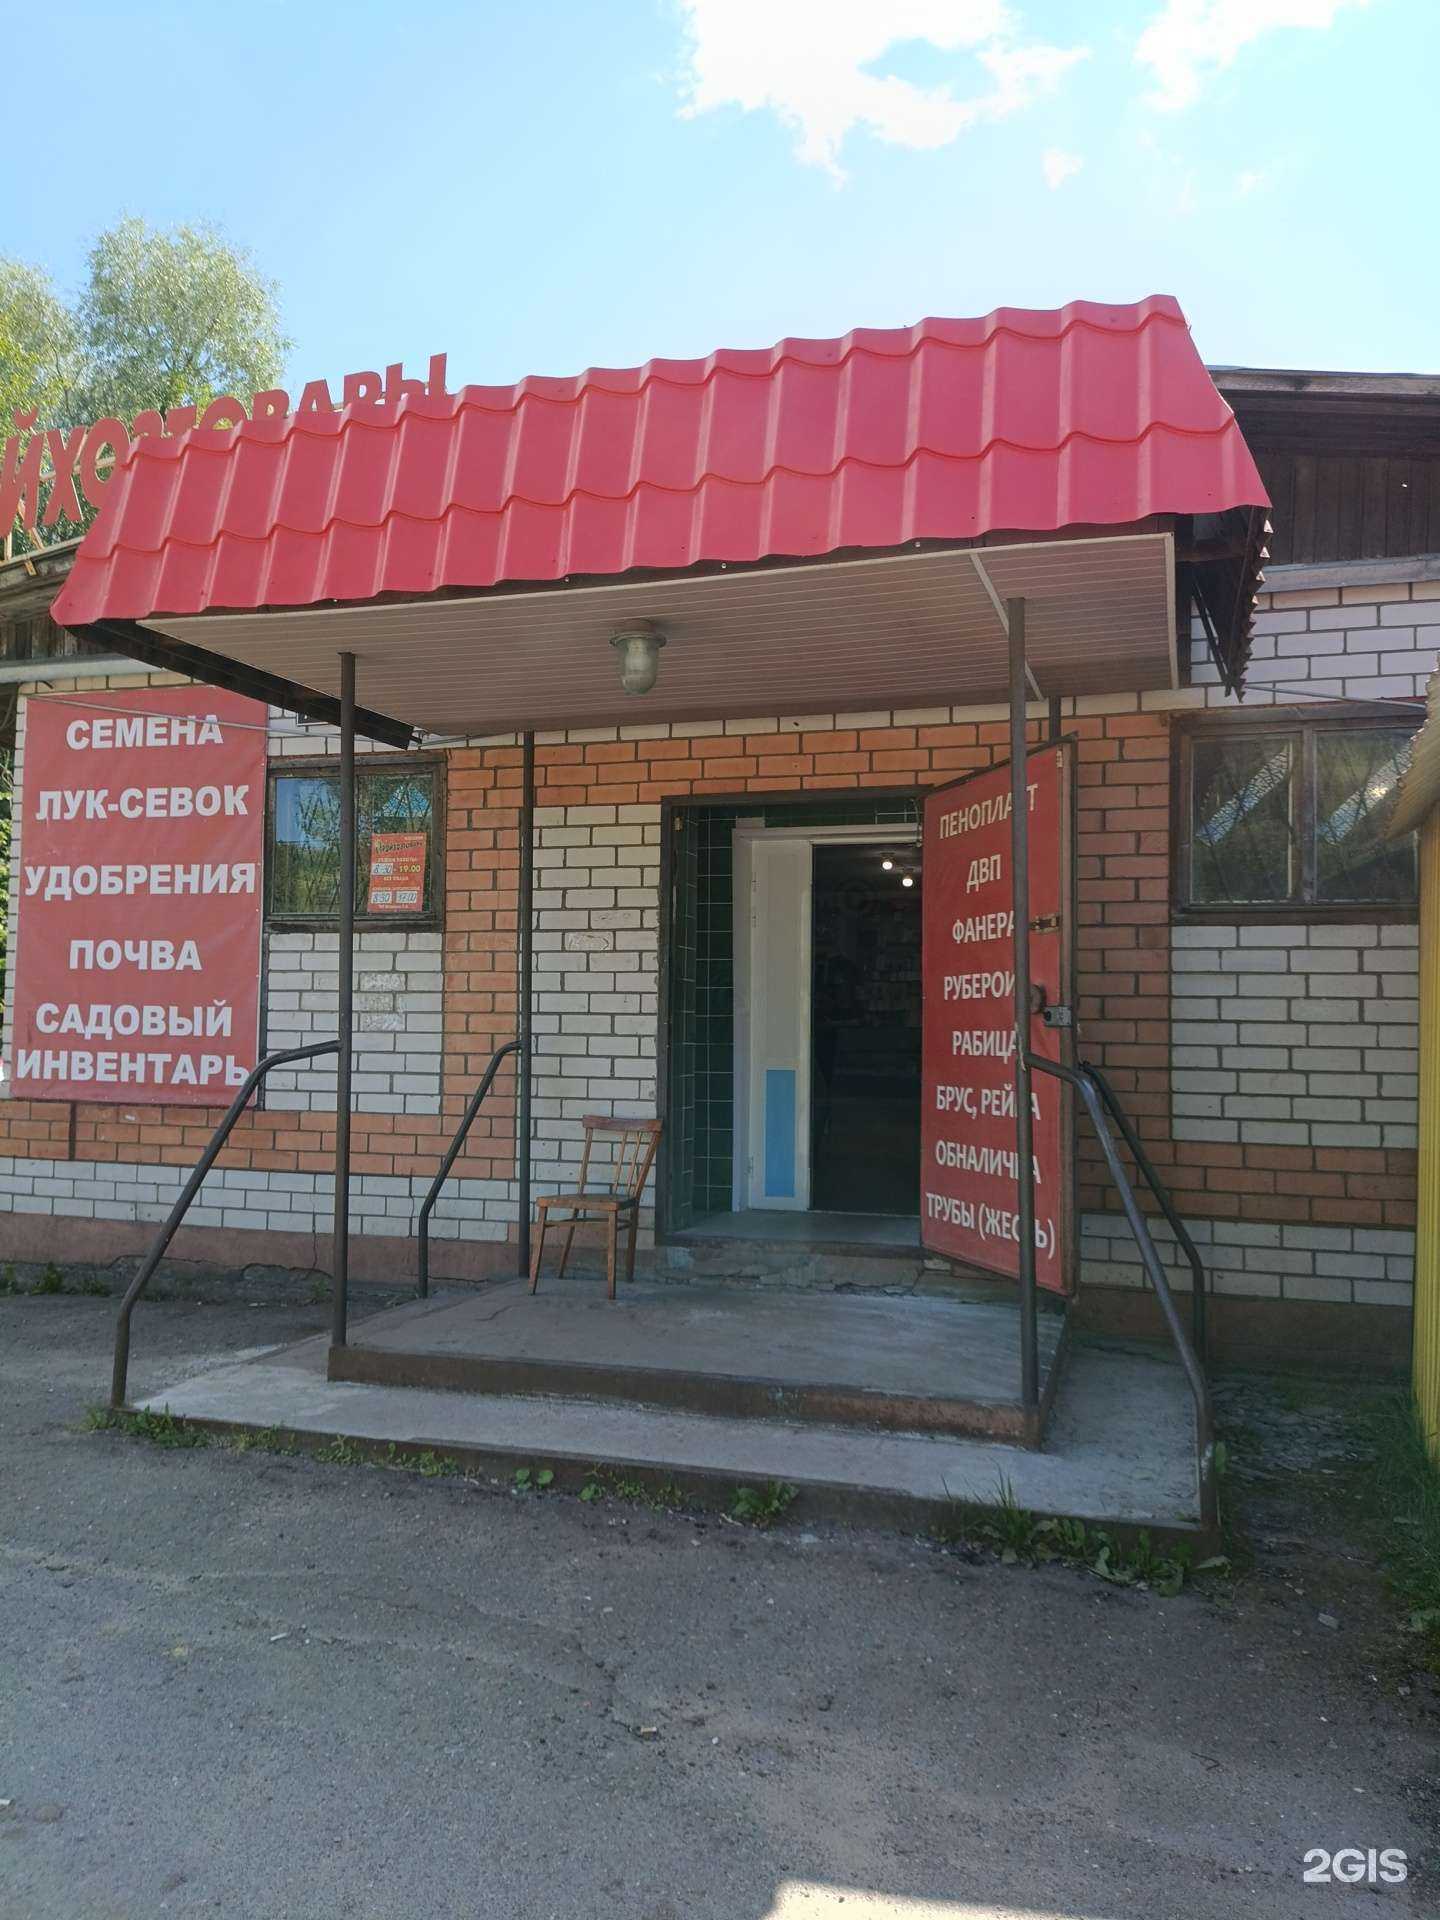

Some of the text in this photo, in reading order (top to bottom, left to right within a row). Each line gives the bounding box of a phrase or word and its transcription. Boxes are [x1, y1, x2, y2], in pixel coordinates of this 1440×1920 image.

[66, 714, 224, 750] СЕМЕНА
[35, 785, 249, 820] ЛУК-СЕВОК
[939, 783, 1039, 839] ПЕНОПЛАТ
[24, 863, 256, 900] УДОБРЕНИЯ
[966, 854, 1002, 893] ДВП
[69, 939, 203, 971] ПОЧВА
[35, 999, 233, 1040] САДОВЫЙ
[16, 1049, 250, 1086] ИНВЕНТАРЬ
[936, 1083, 1041, 1120] БРУС, РЕЙА
[926, 1192, 1055, 1260] ТРУБЫ (ЖЕСЬ)
